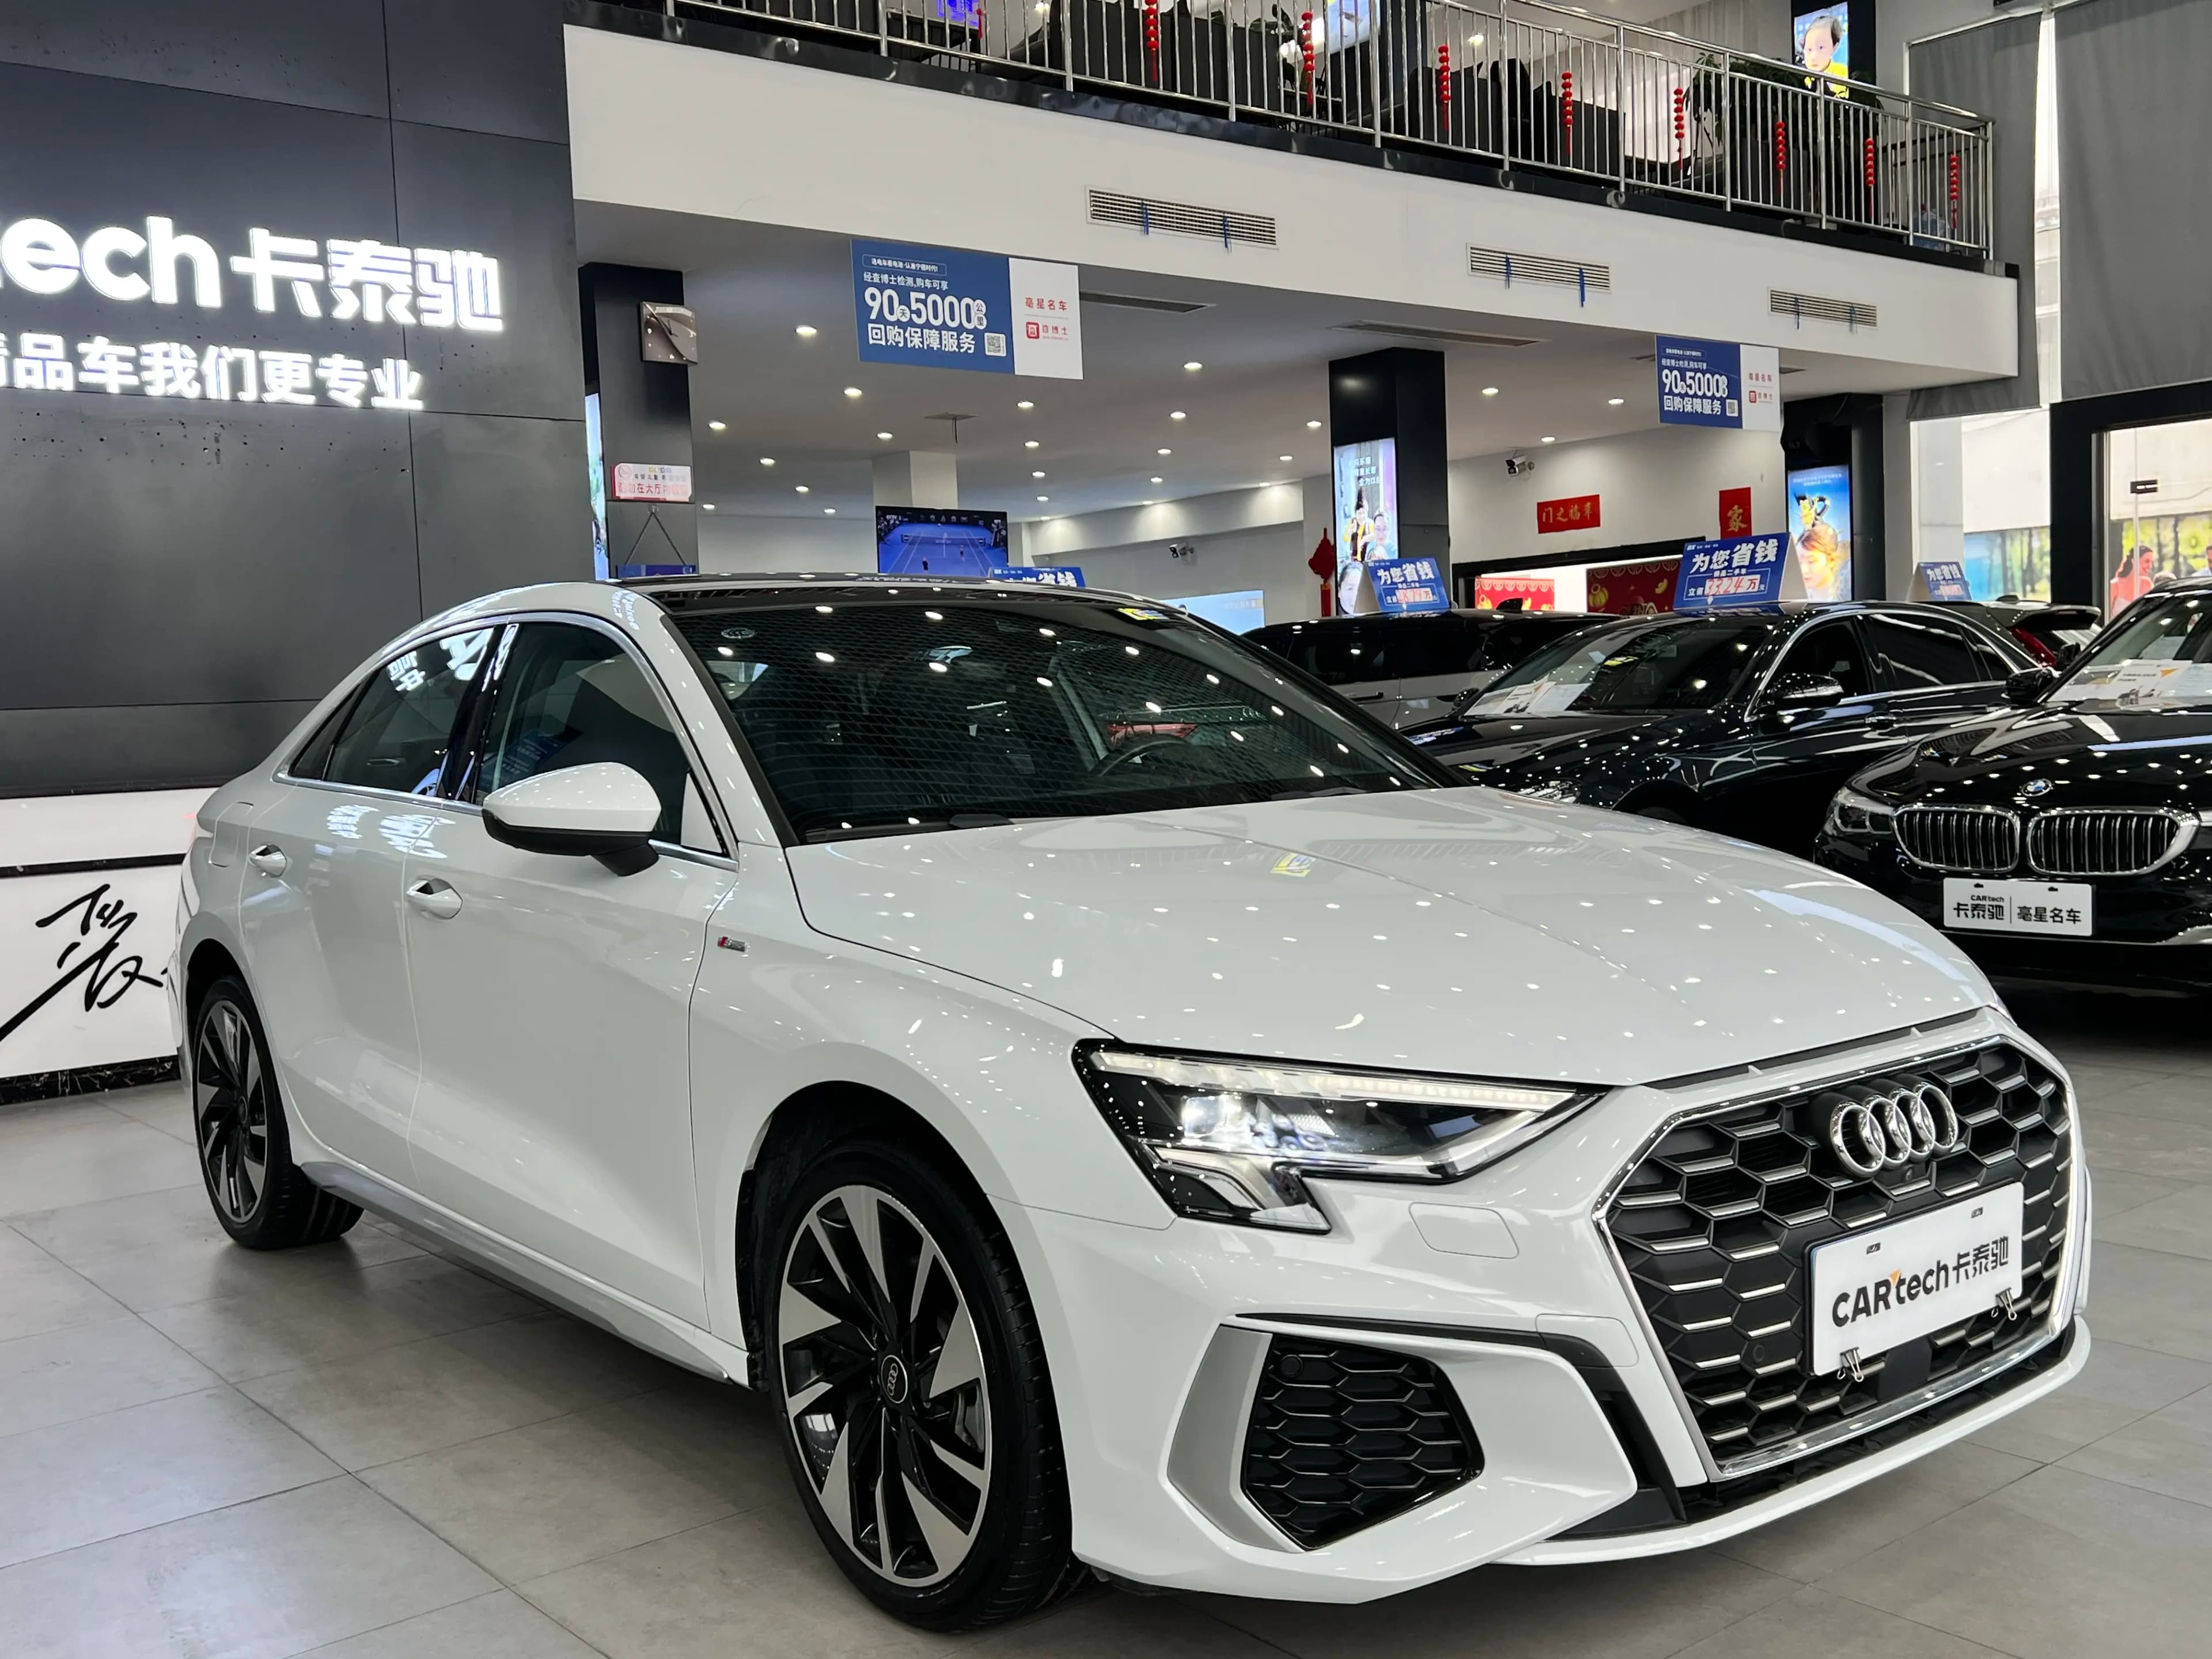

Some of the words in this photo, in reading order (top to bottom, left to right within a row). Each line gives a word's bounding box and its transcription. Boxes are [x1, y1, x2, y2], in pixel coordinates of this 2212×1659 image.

[0, 215, 223, 309] ech
[230, 226, 503, 332] 卡泰驰
[863, 271, 949, 290] 经查博士检测,购车可享
[867, 323, 976, 354] 回购保障服务
[1664, 395, 1722, 415] 回购保障服务
[1689, 538, 1779, 574] 为您省钱
[1376, 560, 1435, 586] 为您省钱
[1953, 902, 2005, 921] 卡泰驰
[1832, 1259, 1949, 1328] CARtech
[1952, 1234, 2009, 1285] 卡泰驰
